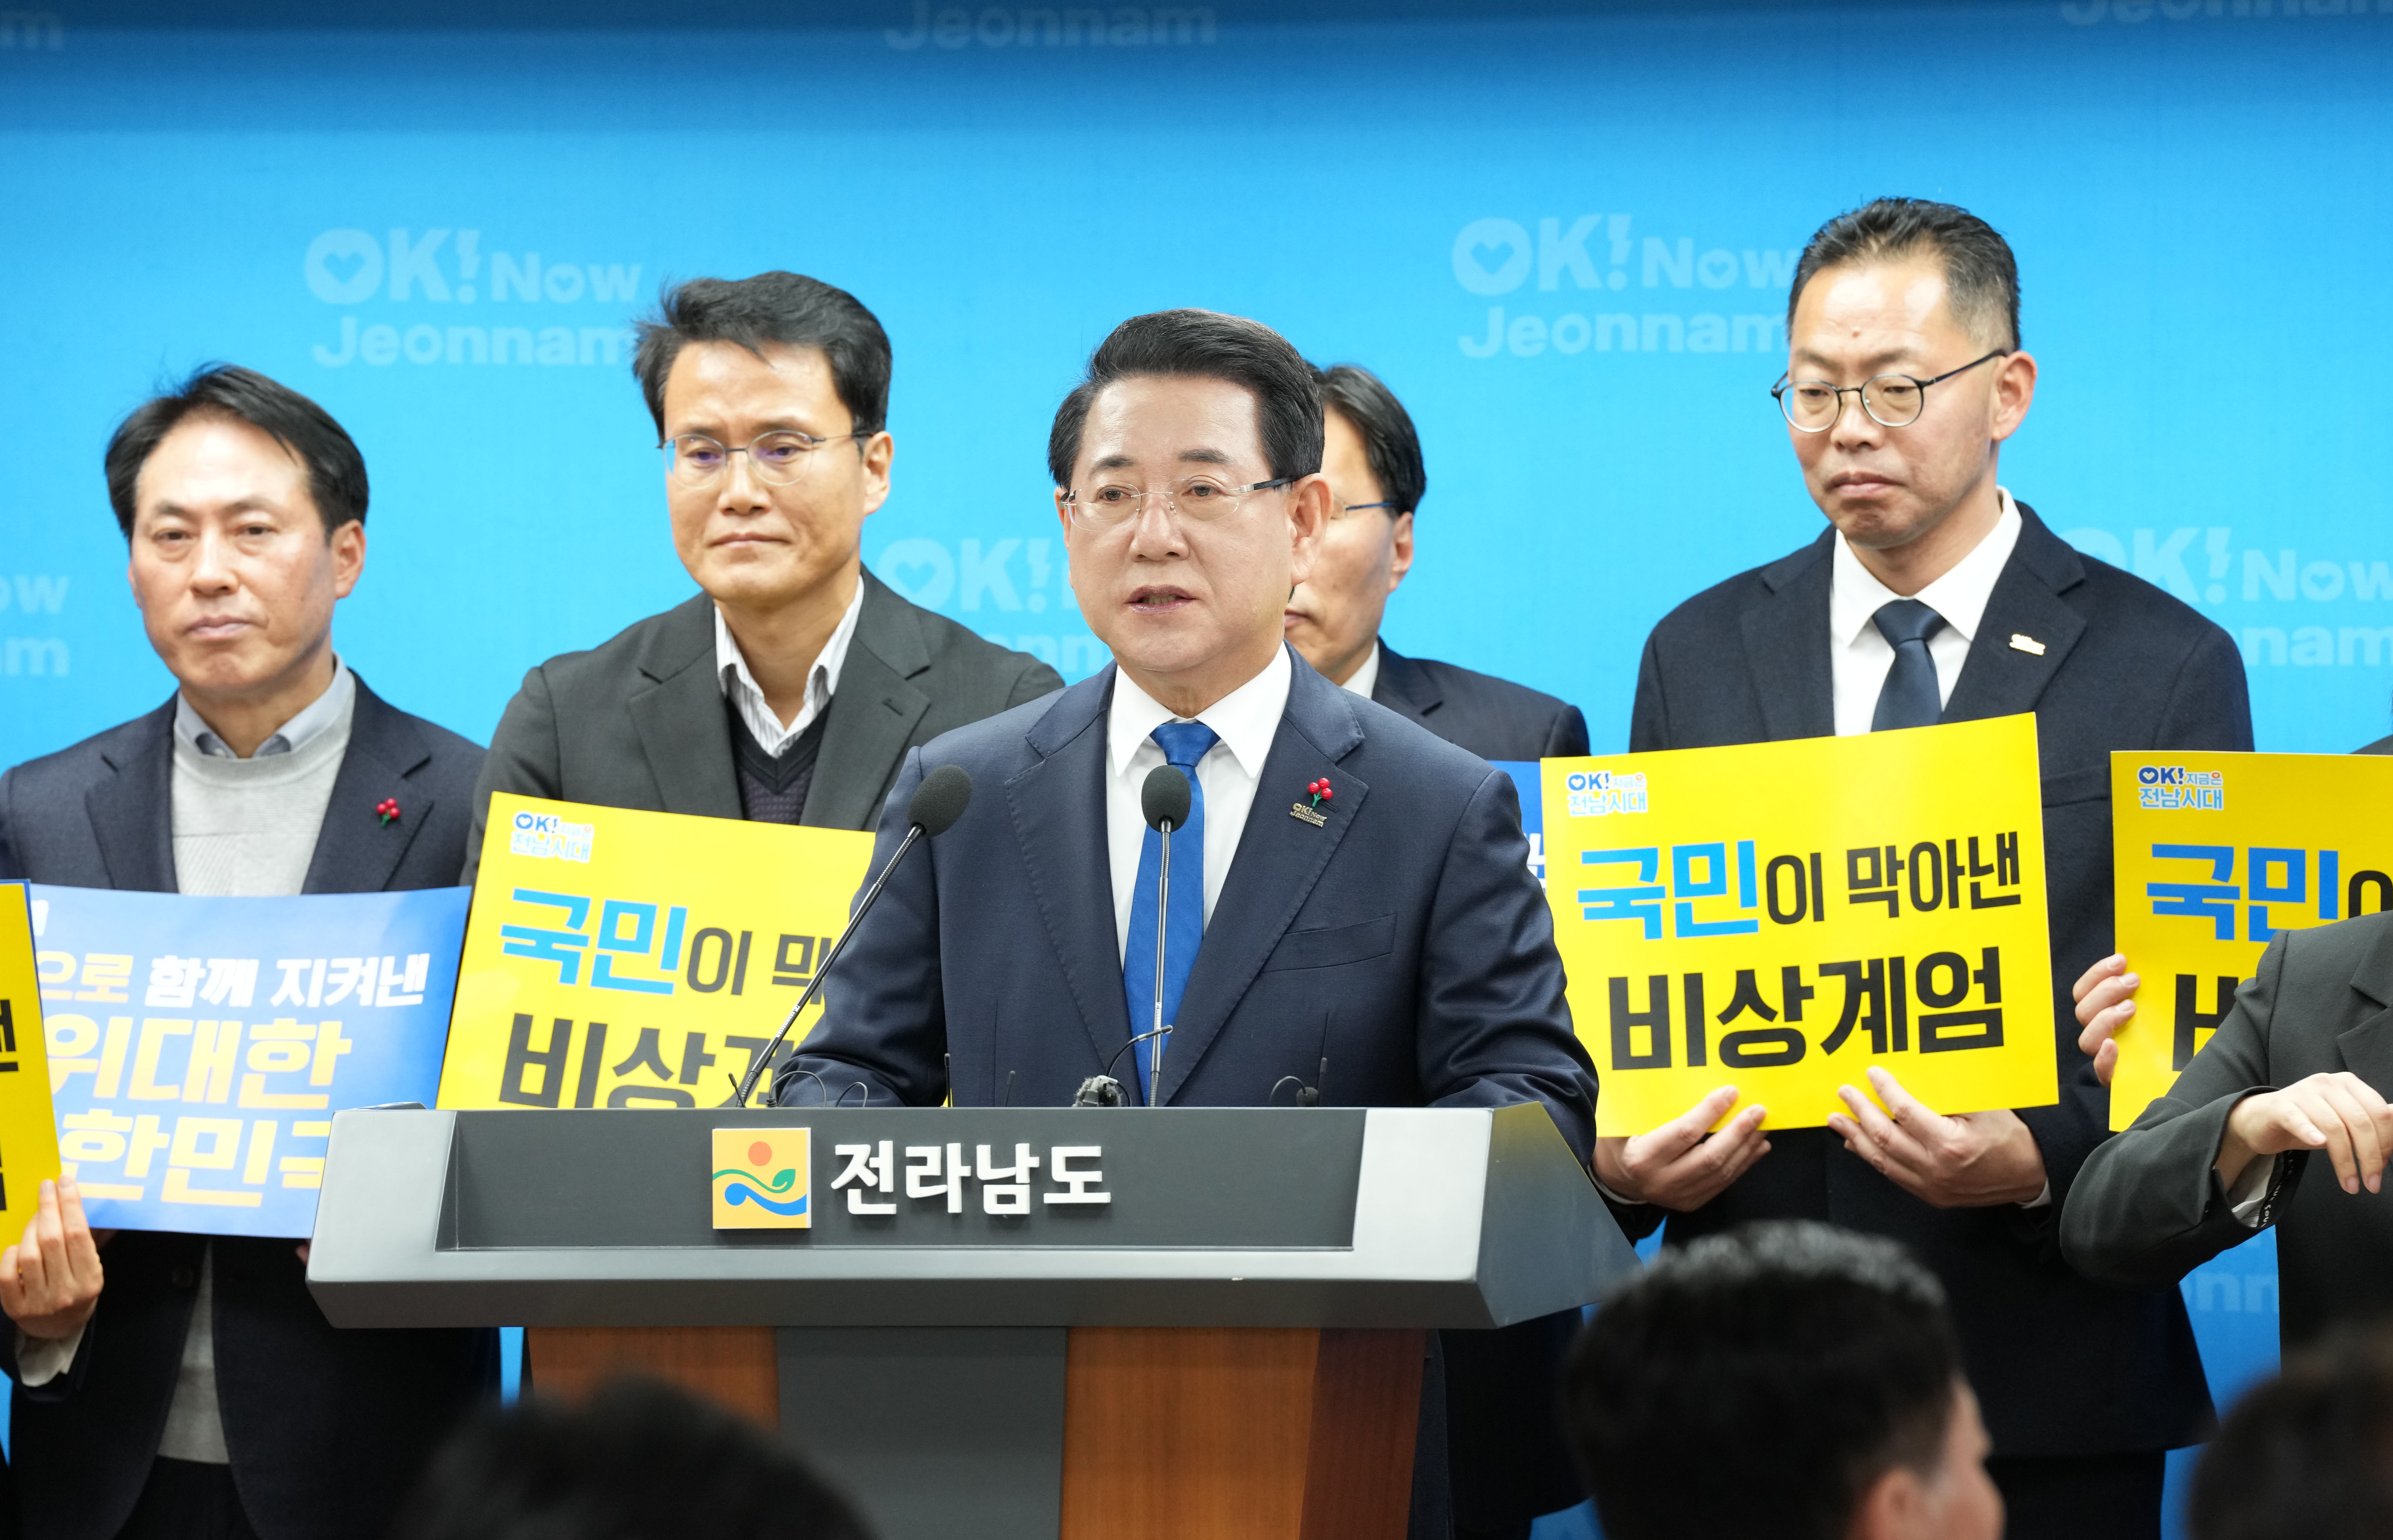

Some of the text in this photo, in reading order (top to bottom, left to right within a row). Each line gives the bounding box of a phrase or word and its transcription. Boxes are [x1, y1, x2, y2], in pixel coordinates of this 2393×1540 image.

[882, 0, 1217, 51] Jeonnam
[304, 228, 642, 305] OK! Now
[1451, 214, 1799, 296] OK! Now
[1568, 773, 1609, 791] OK!
[2139, 767, 2222, 785] OK! 지금은
[2139, 788, 2222, 809] 전남시대
[516, 814, 558, 834] OK!
[1292, 803, 1313, 815] OK!
[1570, 792, 1646, 815] 전남시대
[513, 833, 590, 860] 전남시대
[1577, 839, 1825, 940] 국민이
[1846, 831, 2022, 918] 막아낸
[501, 888, 753, 995] 국민이
[144, 955, 260, 1007] 함께
[270, 953, 430, 1007] 지켜낸
[1608, 946, 2005, 1071] 비상계엄
[44, 1014, 352, 1109] 위대한
[831, 1140, 1111, 1215] 전라남도
